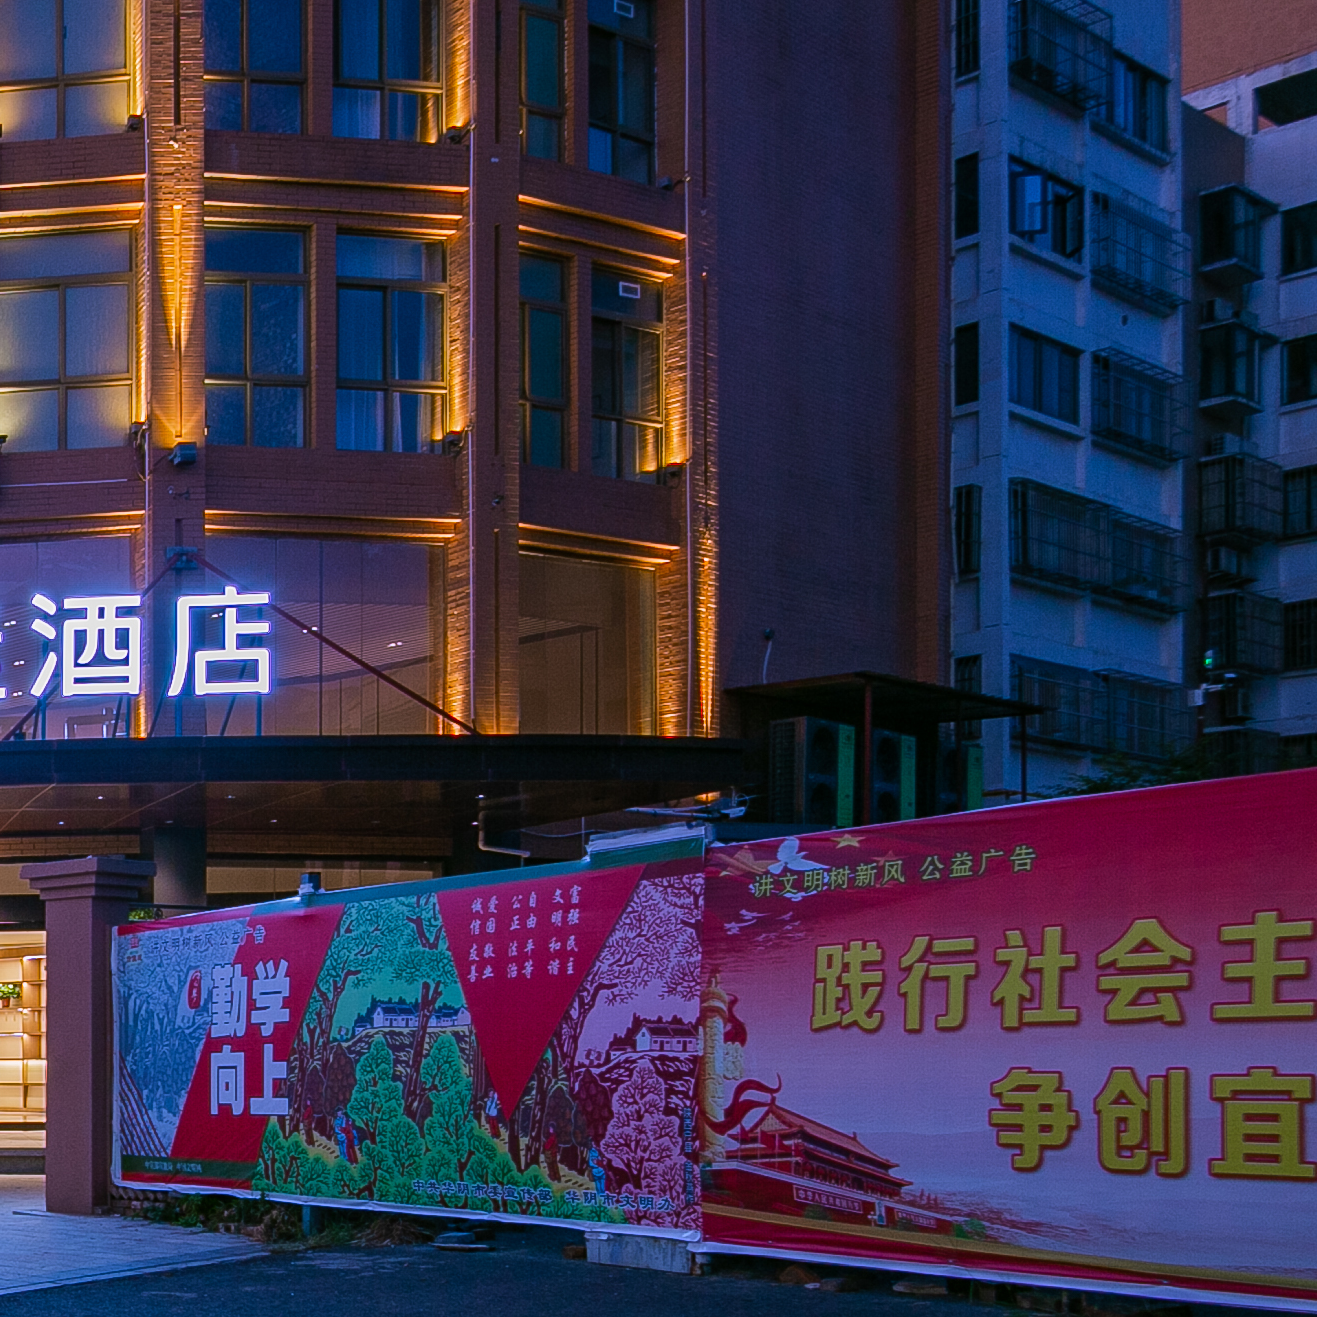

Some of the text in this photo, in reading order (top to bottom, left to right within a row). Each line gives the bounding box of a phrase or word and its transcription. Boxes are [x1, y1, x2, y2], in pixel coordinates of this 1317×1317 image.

[752, 844, 1037, 897] 讲文明树新风 公益广告
[209, 957, 291, 1039] 勤学
[809, 909, 1316, 1033] 践行社会主
[209, 1042, 290, 1117] 向上
[989, 1066, 1316, 1180] 争创宜
[412, 1179, 676, 1212] 中共华阴市委宣传部 华阴市文明办
